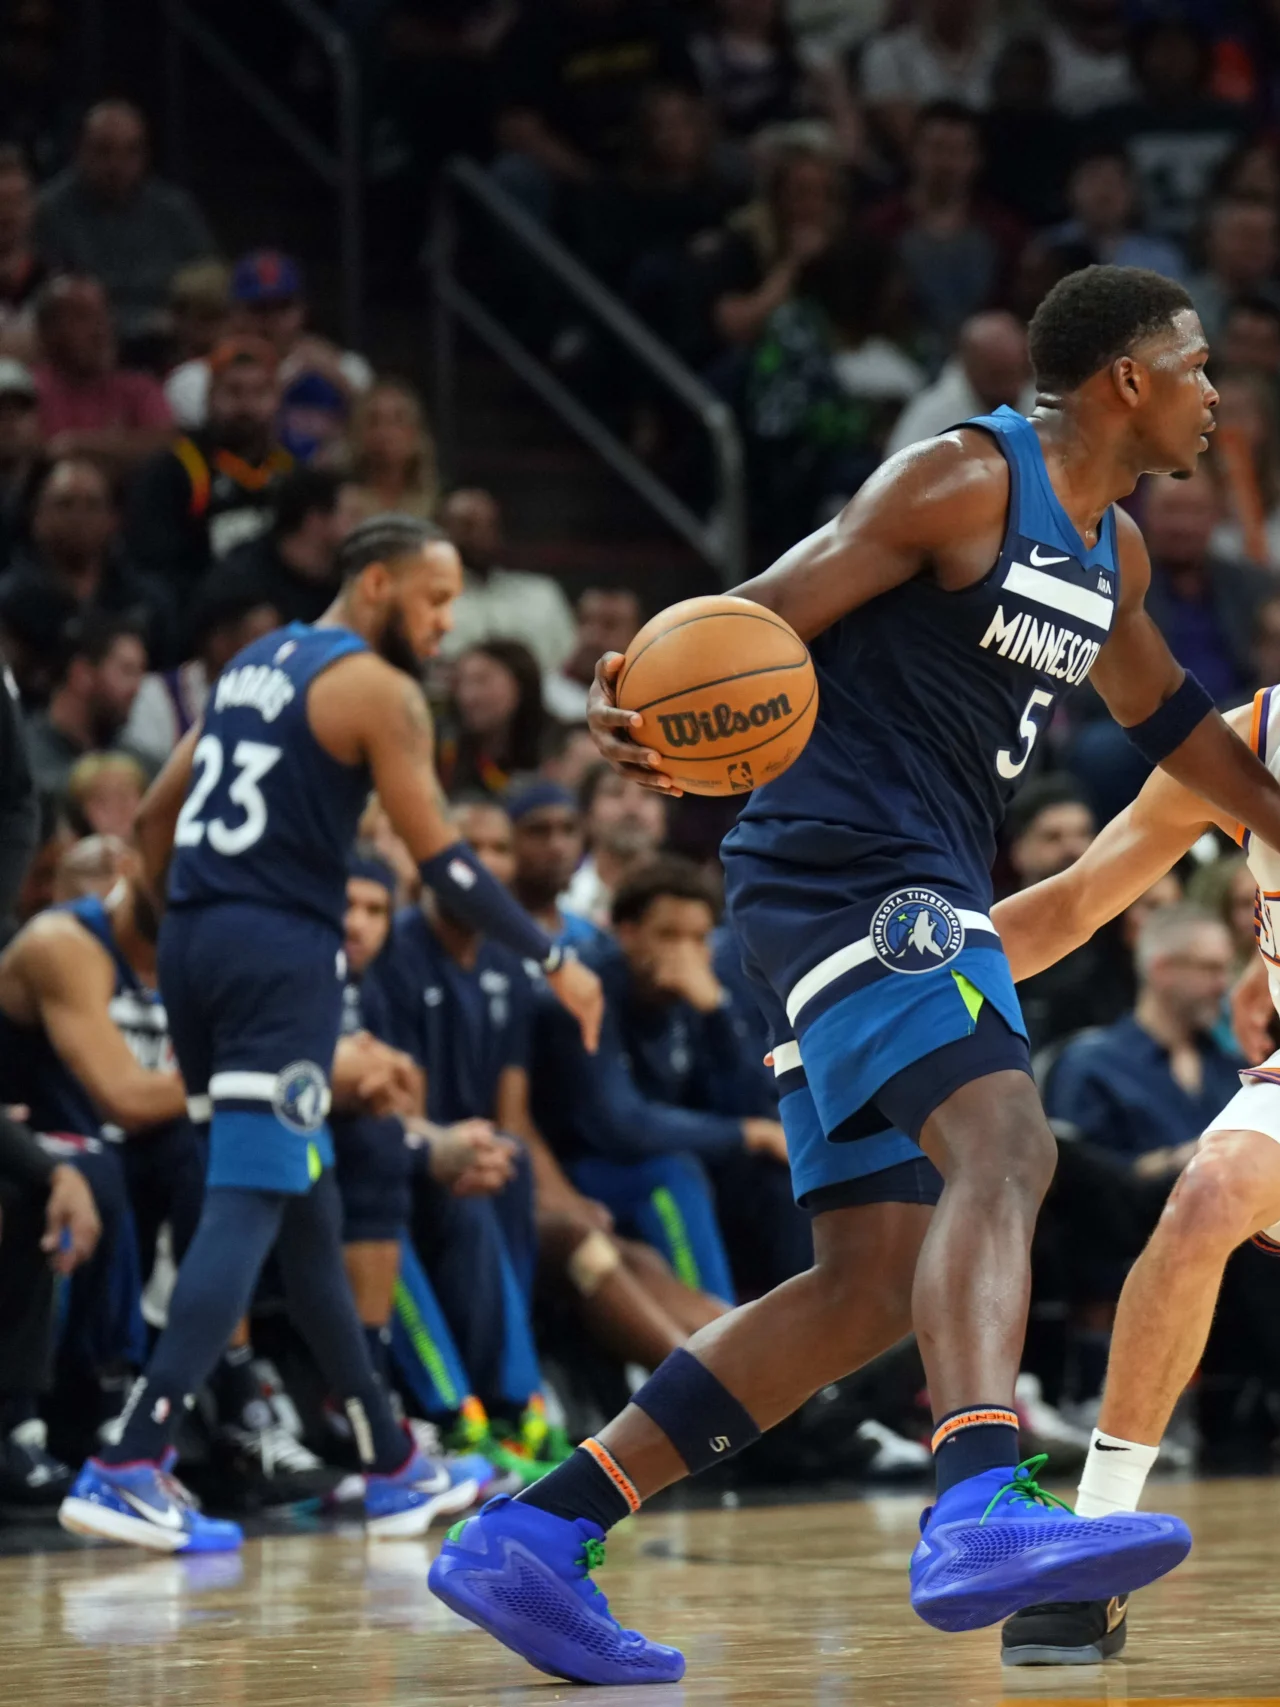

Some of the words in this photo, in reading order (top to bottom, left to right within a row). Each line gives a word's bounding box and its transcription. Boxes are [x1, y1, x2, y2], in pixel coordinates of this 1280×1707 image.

[979, 604, 1101, 686] MINNESOT
[657, 693, 792, 748] Wilson
[996, 689, 1054, 779] 5
[173, 733, 283, 857] 23
[875, 897, 903, 956] MINNESOTA
[907, 892, 960, 950] TIMBERWOLVES
[708, 1436, 731, 1453] 5
